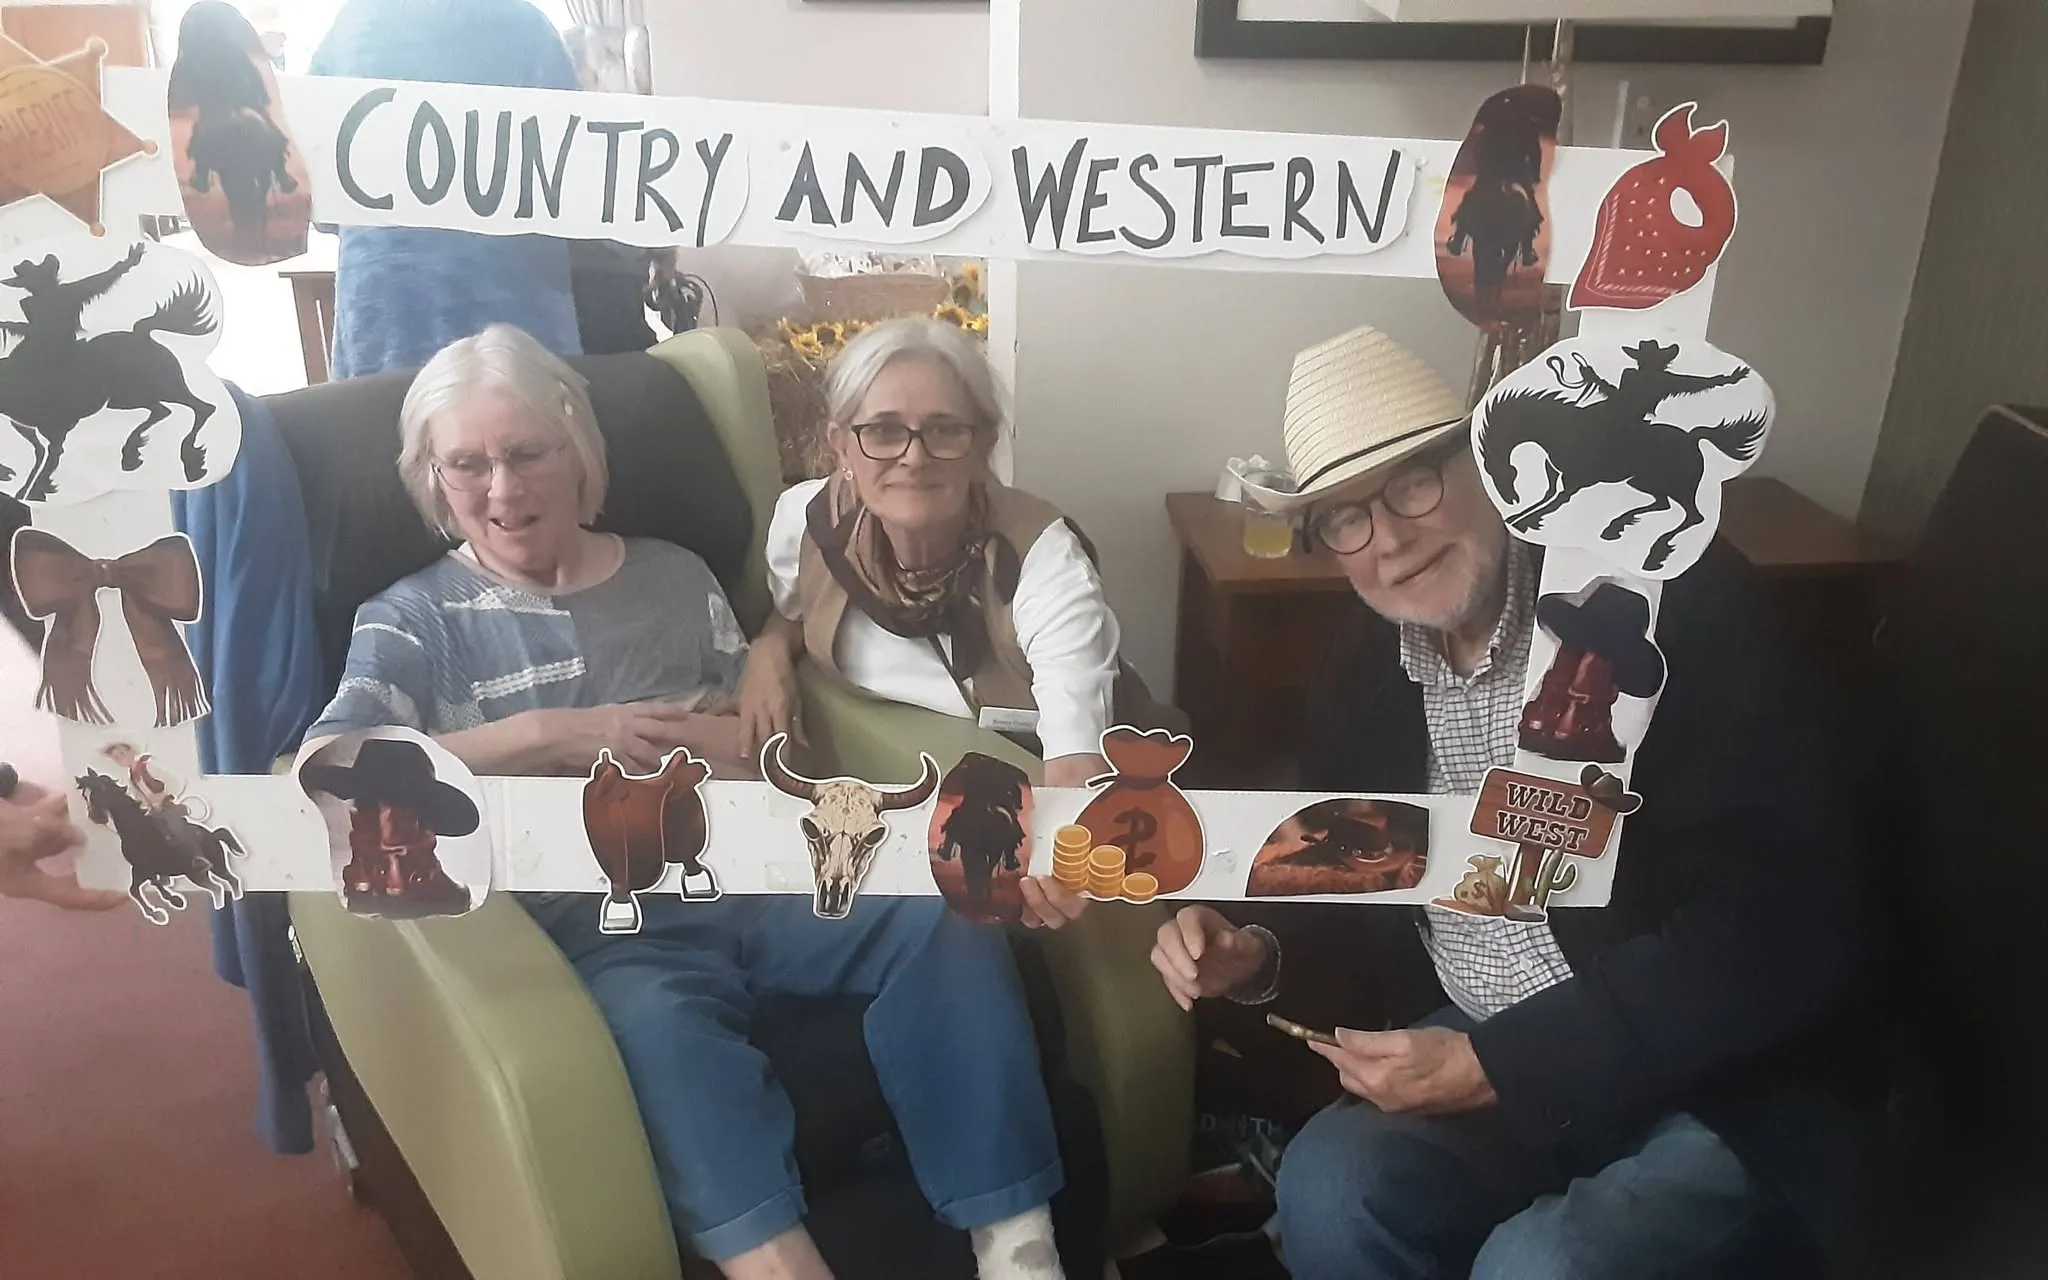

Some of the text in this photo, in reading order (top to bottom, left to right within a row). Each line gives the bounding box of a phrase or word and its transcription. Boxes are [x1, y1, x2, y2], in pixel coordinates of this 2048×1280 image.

[336, 87, 1401, 249] COUNTRY AND WESTERN
[1506, 781, 1593, 821] WILD
[1496, 809, 1590, 850] WEST
